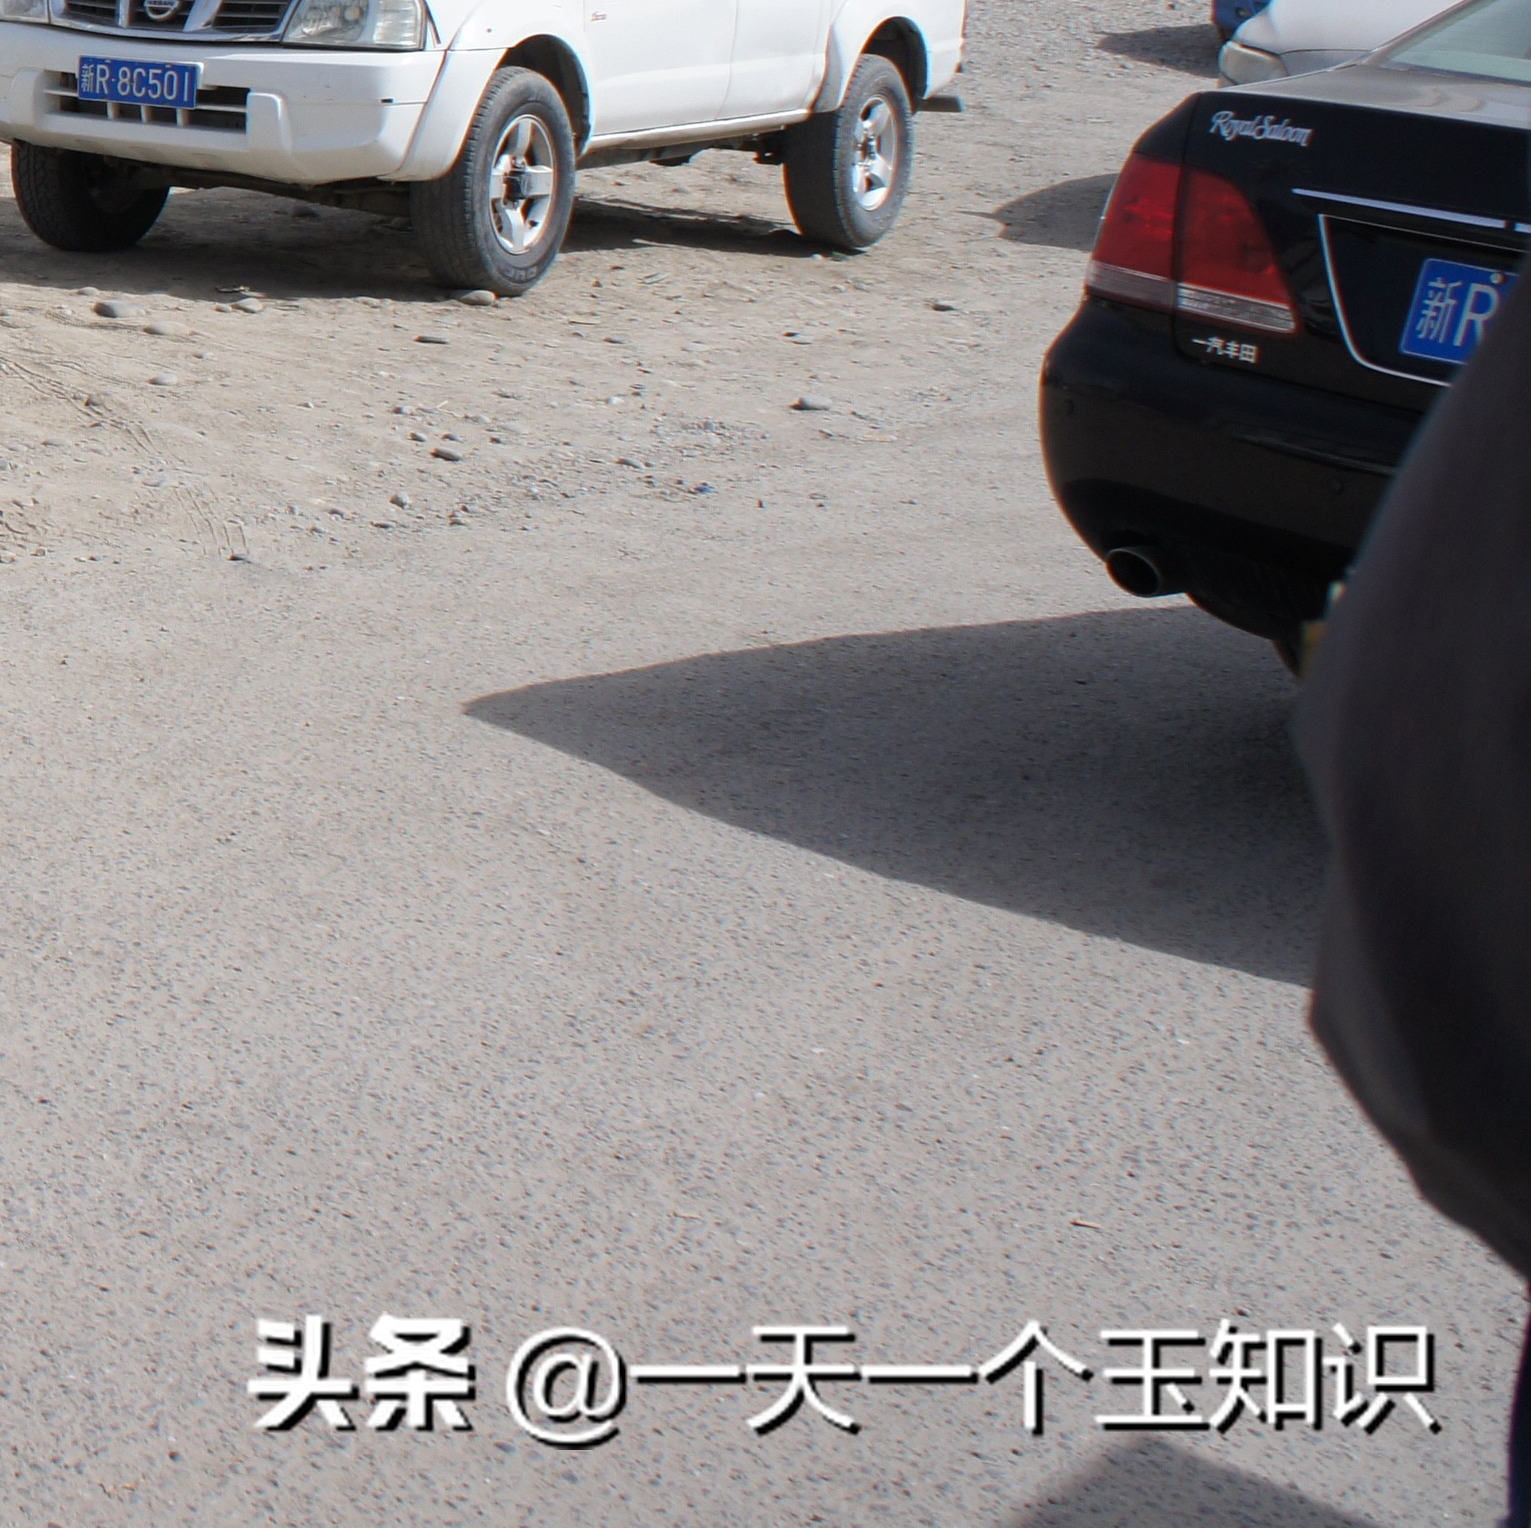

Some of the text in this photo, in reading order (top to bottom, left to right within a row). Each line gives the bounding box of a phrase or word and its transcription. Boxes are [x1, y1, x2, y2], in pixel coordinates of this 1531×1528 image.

[1415, 276, 1501, 347] 新R
[1191, 336, 1258, 364] 一汽丰田
